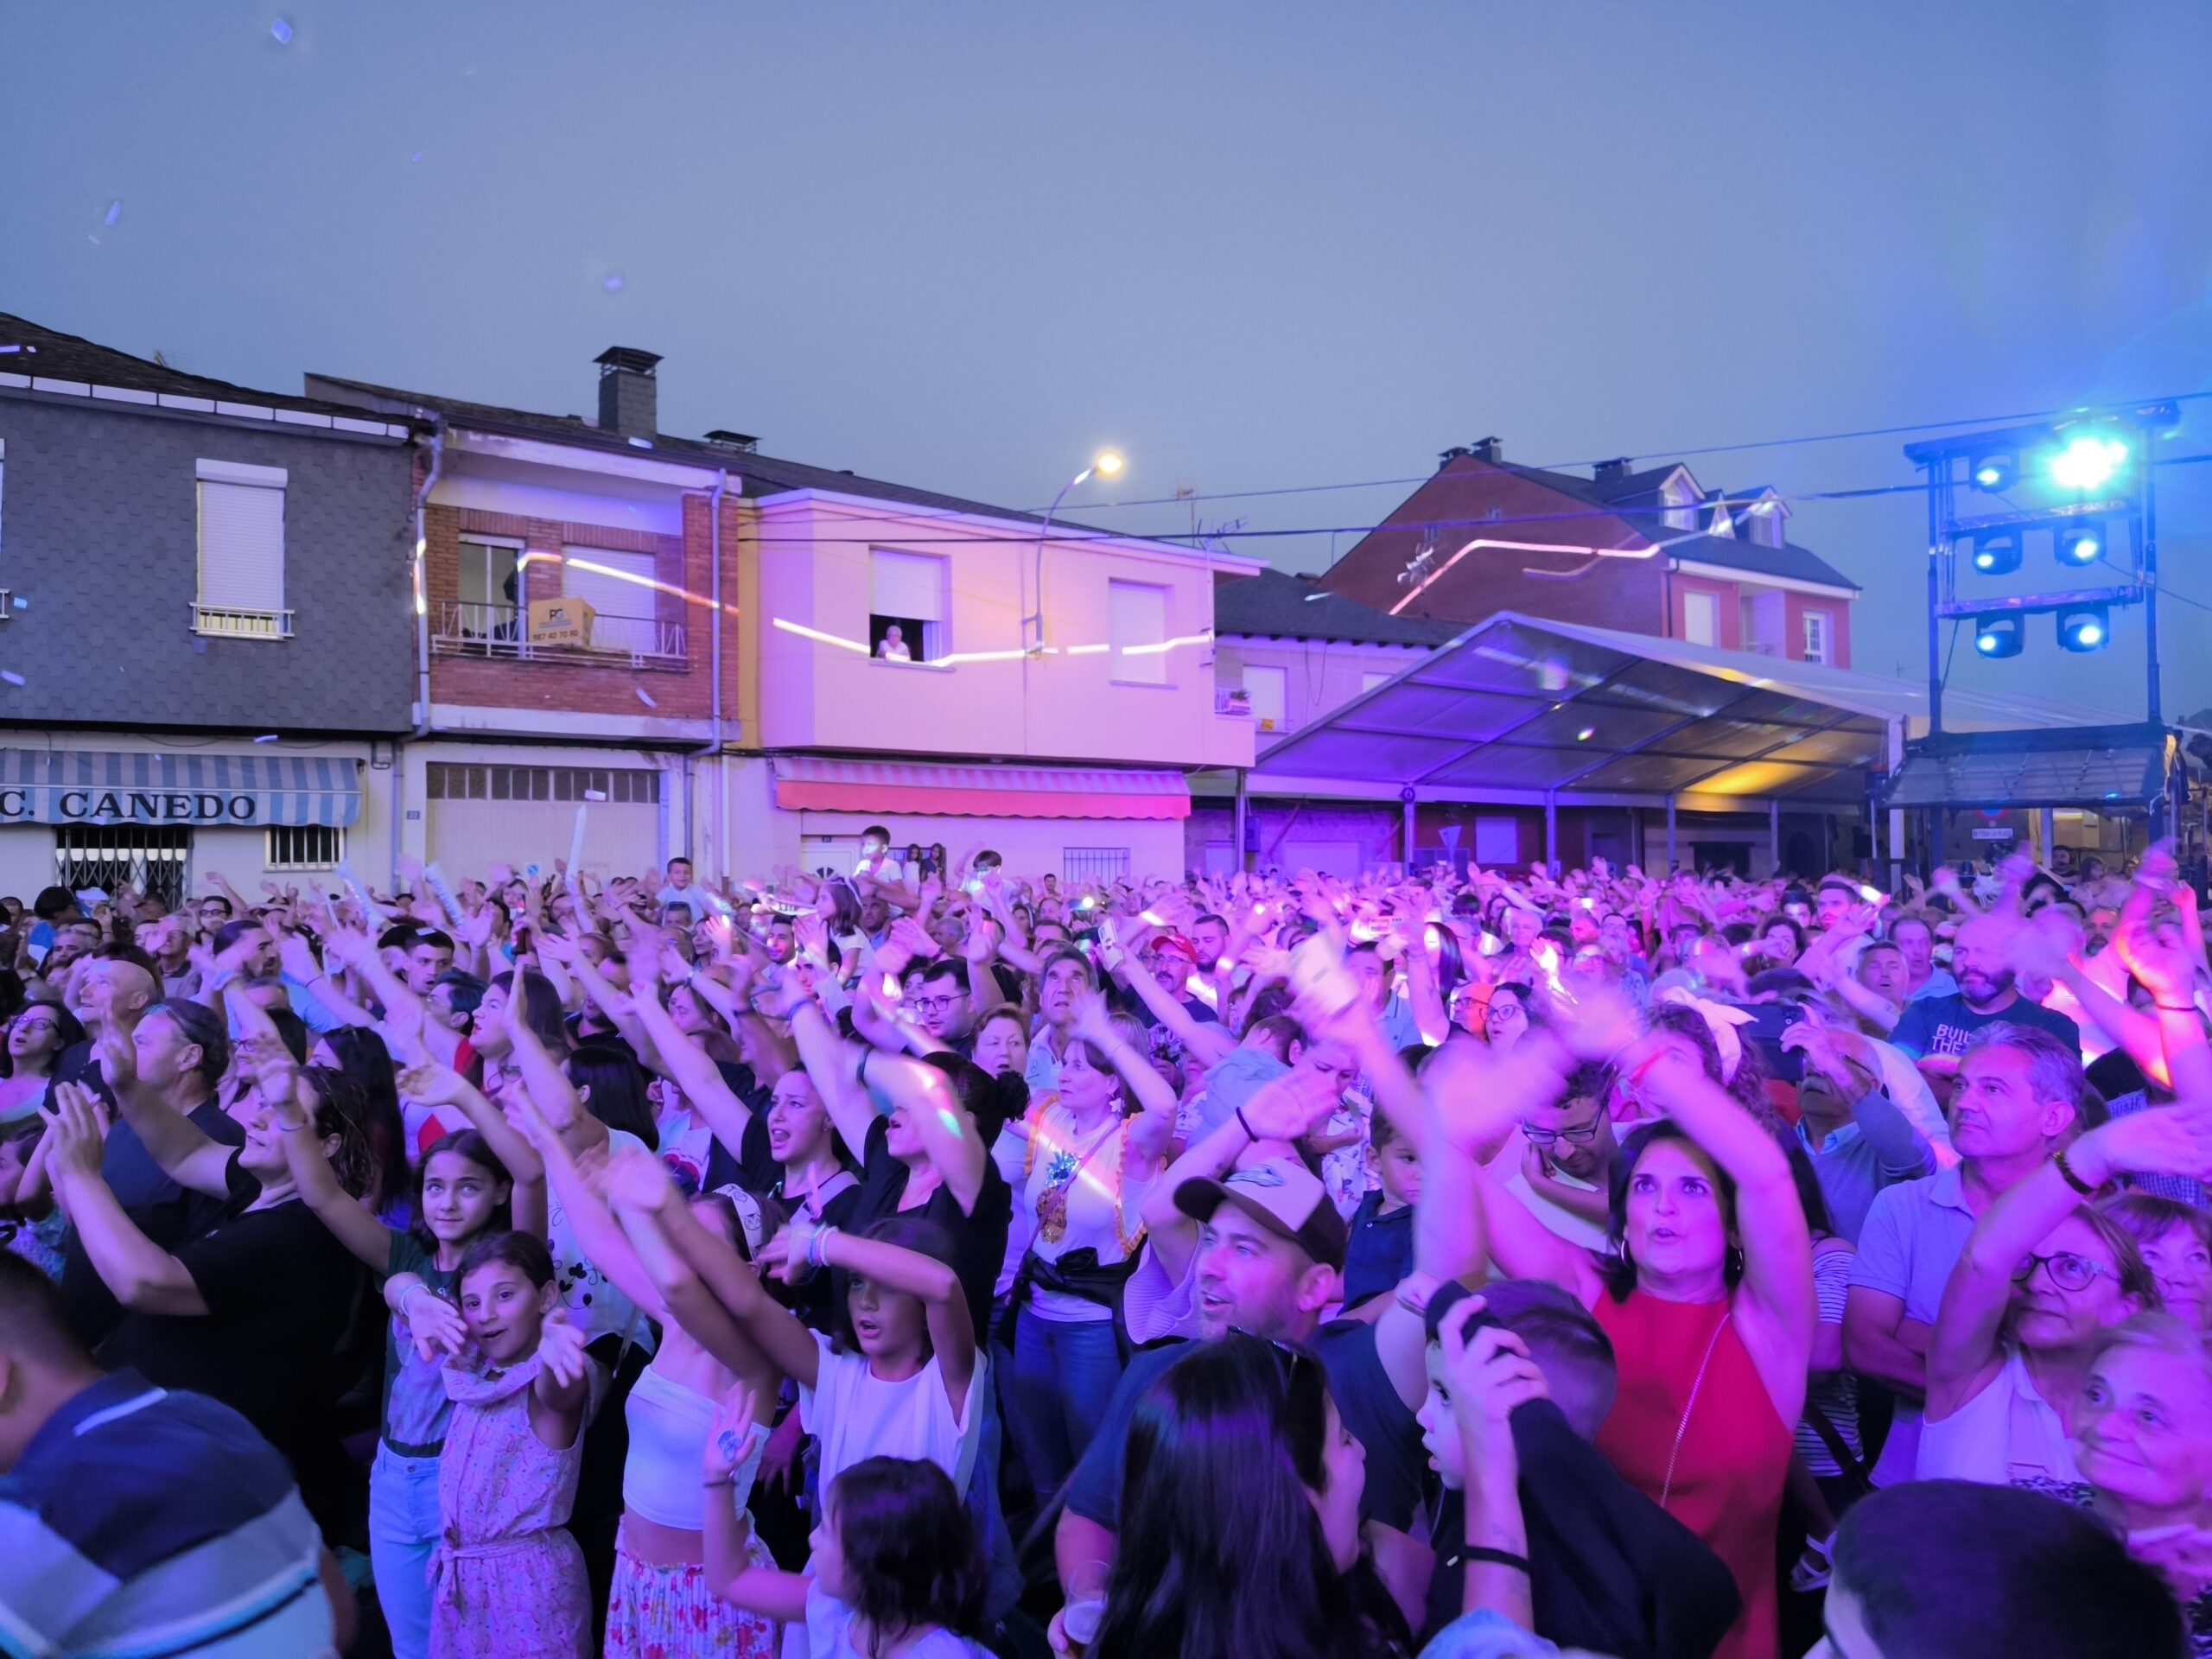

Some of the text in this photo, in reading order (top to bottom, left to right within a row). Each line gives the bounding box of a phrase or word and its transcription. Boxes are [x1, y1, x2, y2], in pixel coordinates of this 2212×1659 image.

[60, 792, 256, 819] CANEDO
[1936, 1023, 1969, 1044] BUIL
[1931, 1035, 1962, 1054] THE
